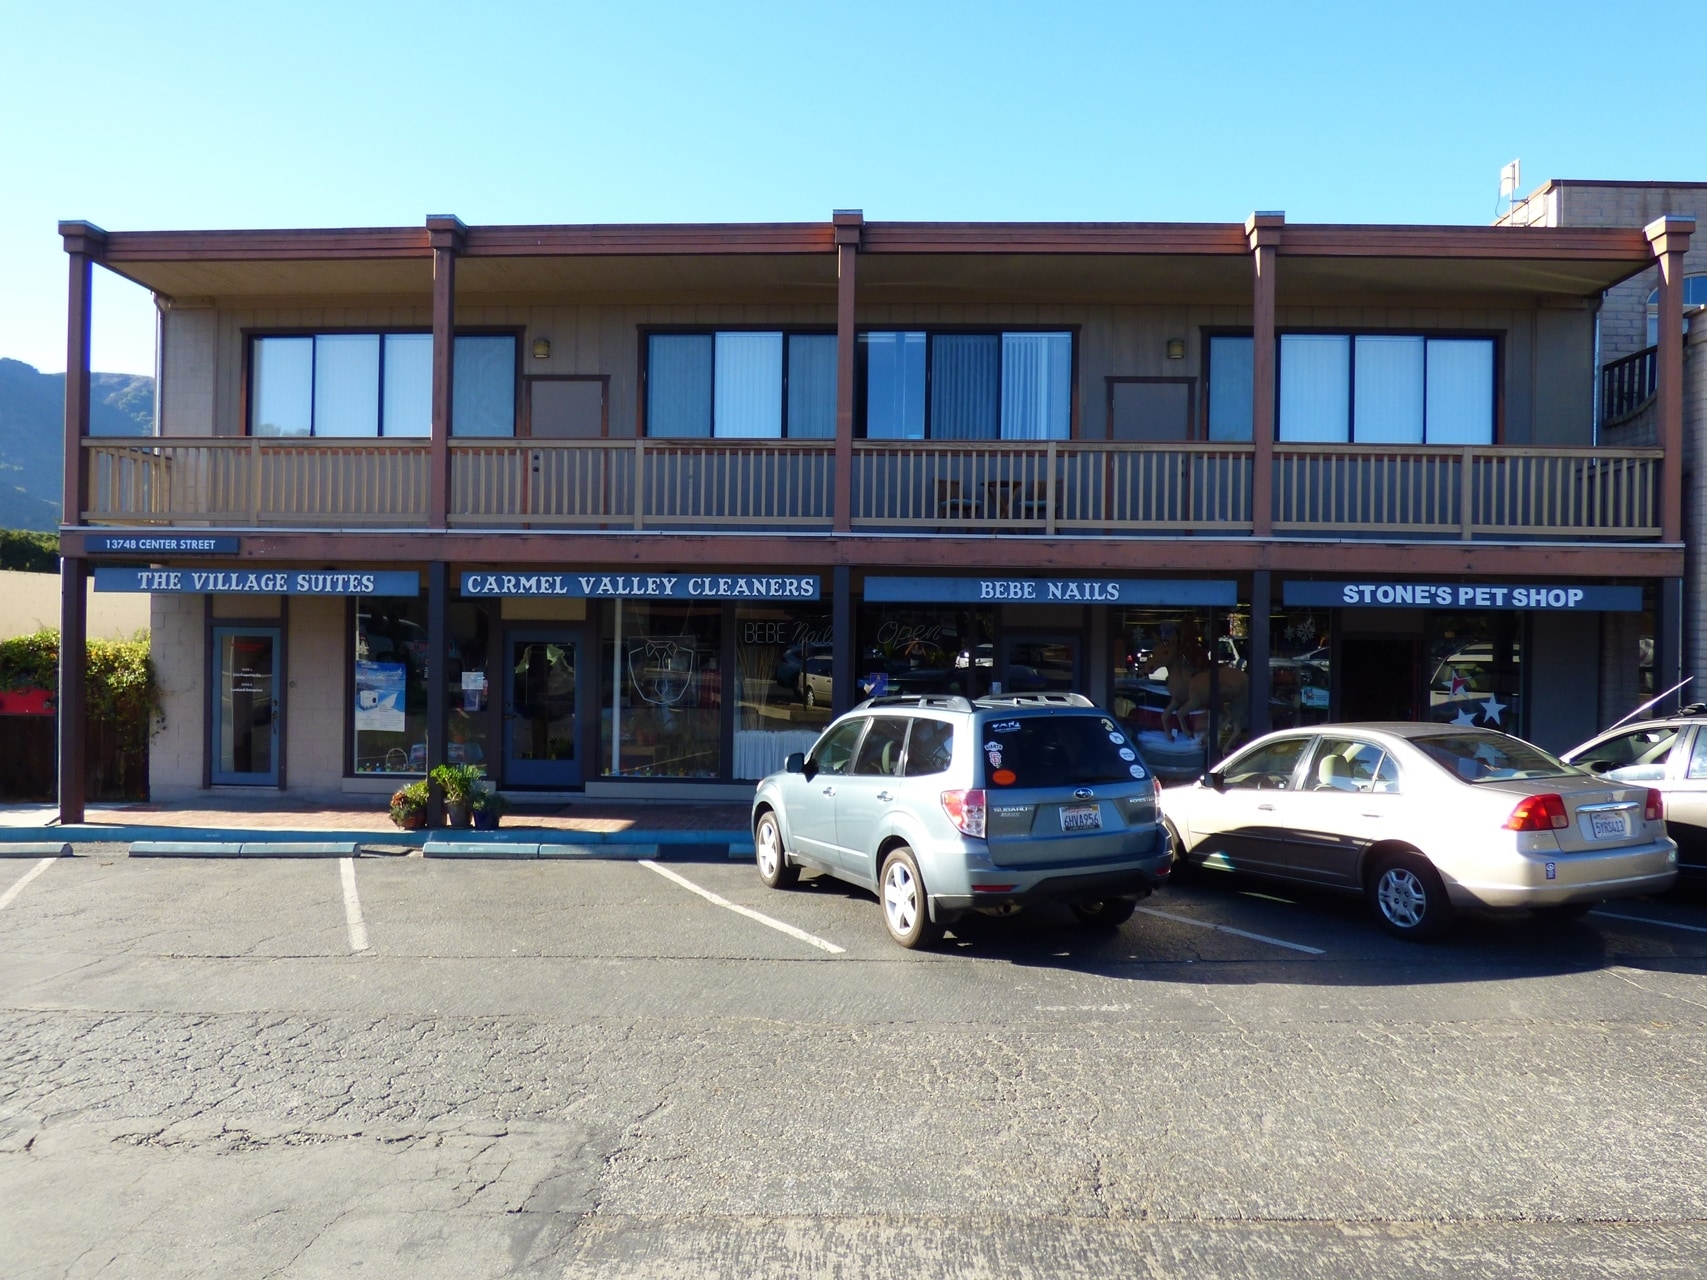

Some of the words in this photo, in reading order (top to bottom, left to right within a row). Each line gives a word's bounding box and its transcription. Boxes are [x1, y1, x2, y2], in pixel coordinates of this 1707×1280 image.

[105, 539, 136, 549] 13748
[139, 539, 177, 549] CENTER
[179, 540, 216, 550] STREET
[137, 572, 181, 590] THE
[191, 572, 288, 591] VILLAGE
[297, 574, 374, 593] SUITES
[467, 575, 568, 594] CARMEL
[578, 577, 677, 595] VALLEY
[688, 578, 815, 597] CLEANERS
[980, 581, 1036, 599] BEBE
[1047, 582, 1120, 600] NAILS
[1342, 585, 1452, 604] STONE'S
[1459, 587, 1508, 606] PET
[1512, 588, 1584, 607] SHOP
[744, 622, 786, 644] BEBE
[877, 621, 941, 649] Open
[1064, 813, 1099, 827] 6HVA956
[1595, 820, 1625, 834] 5YRS413
